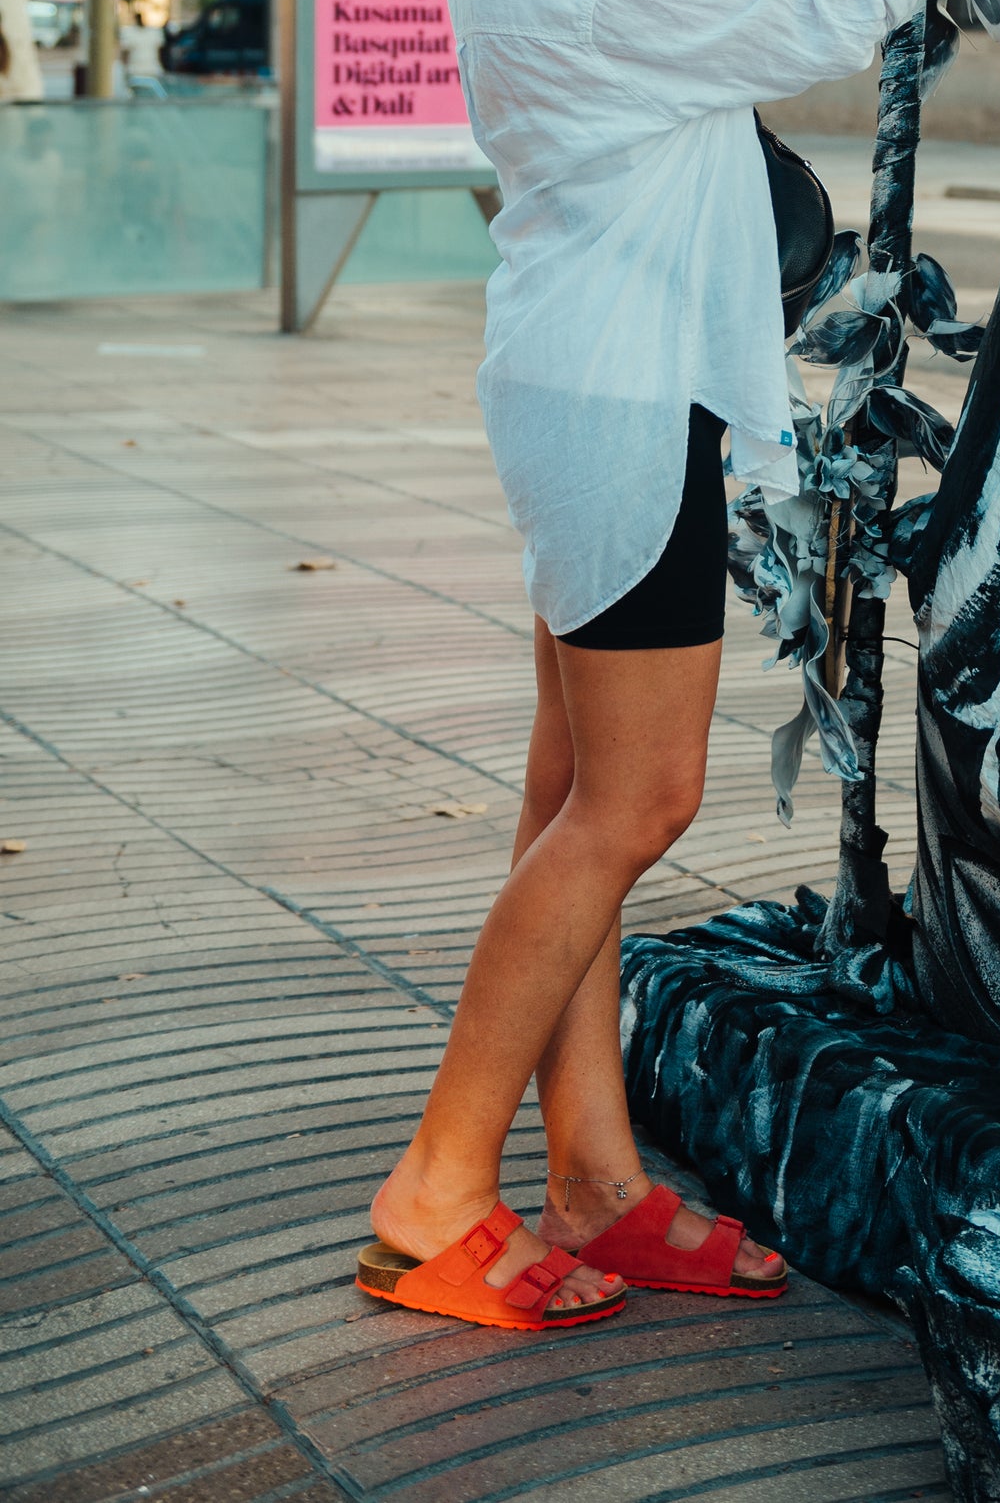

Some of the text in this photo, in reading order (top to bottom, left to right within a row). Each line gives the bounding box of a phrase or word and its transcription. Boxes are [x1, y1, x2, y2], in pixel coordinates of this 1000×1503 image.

[333, 0, 442, 23] Kusama
[333, 29, 449, 59] Basquiat
[333, 60, 421, 87] Digital
[332, 96, 354, 115] &
